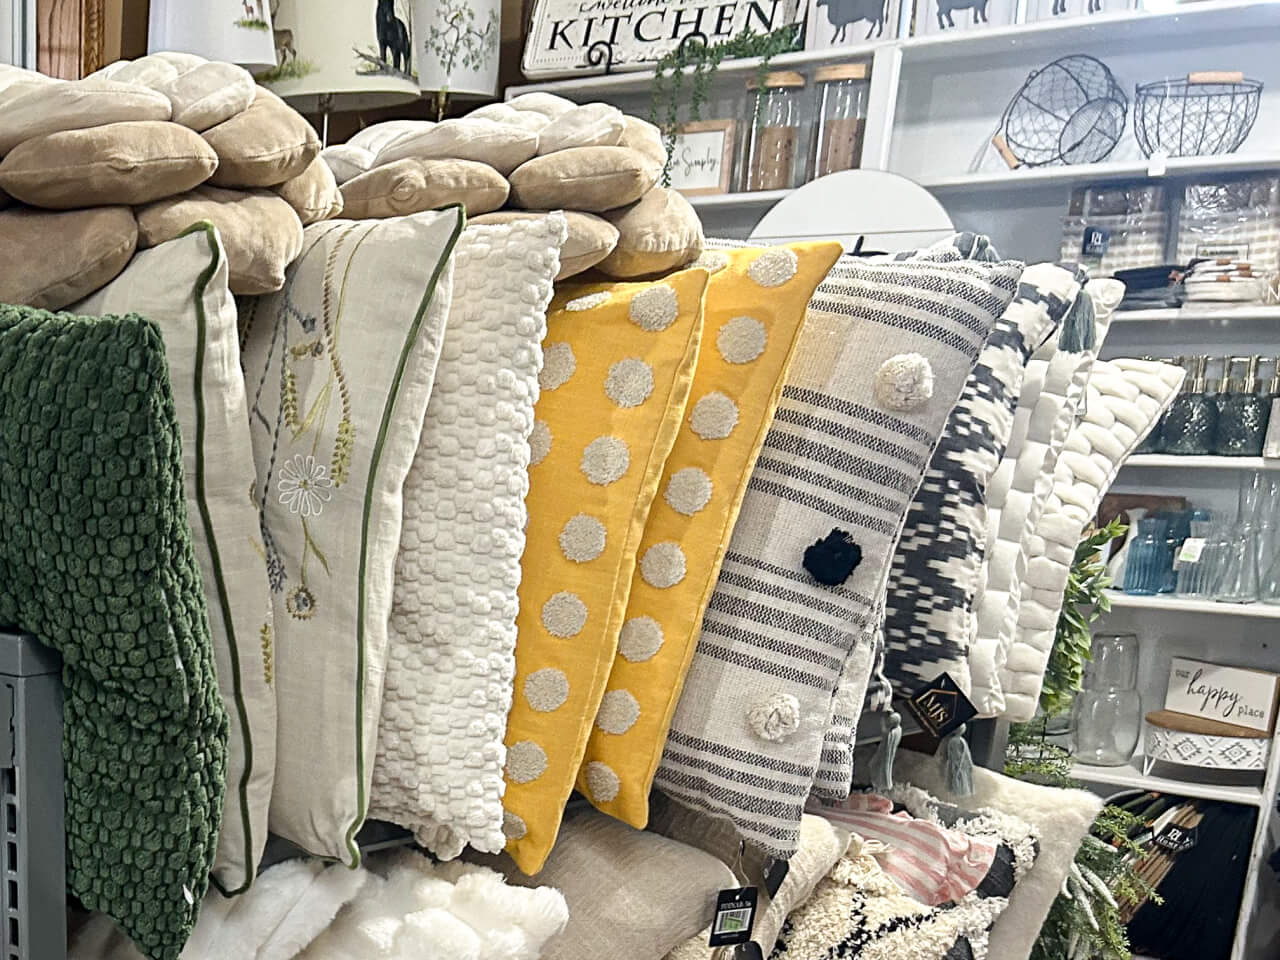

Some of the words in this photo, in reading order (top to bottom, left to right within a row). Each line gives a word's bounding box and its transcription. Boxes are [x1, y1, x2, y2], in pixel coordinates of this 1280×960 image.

[548, 0, 778, 50] KITCHEN
[1186, 668, 1240, 717] happy
[1237, 704, 1265, 719] place
